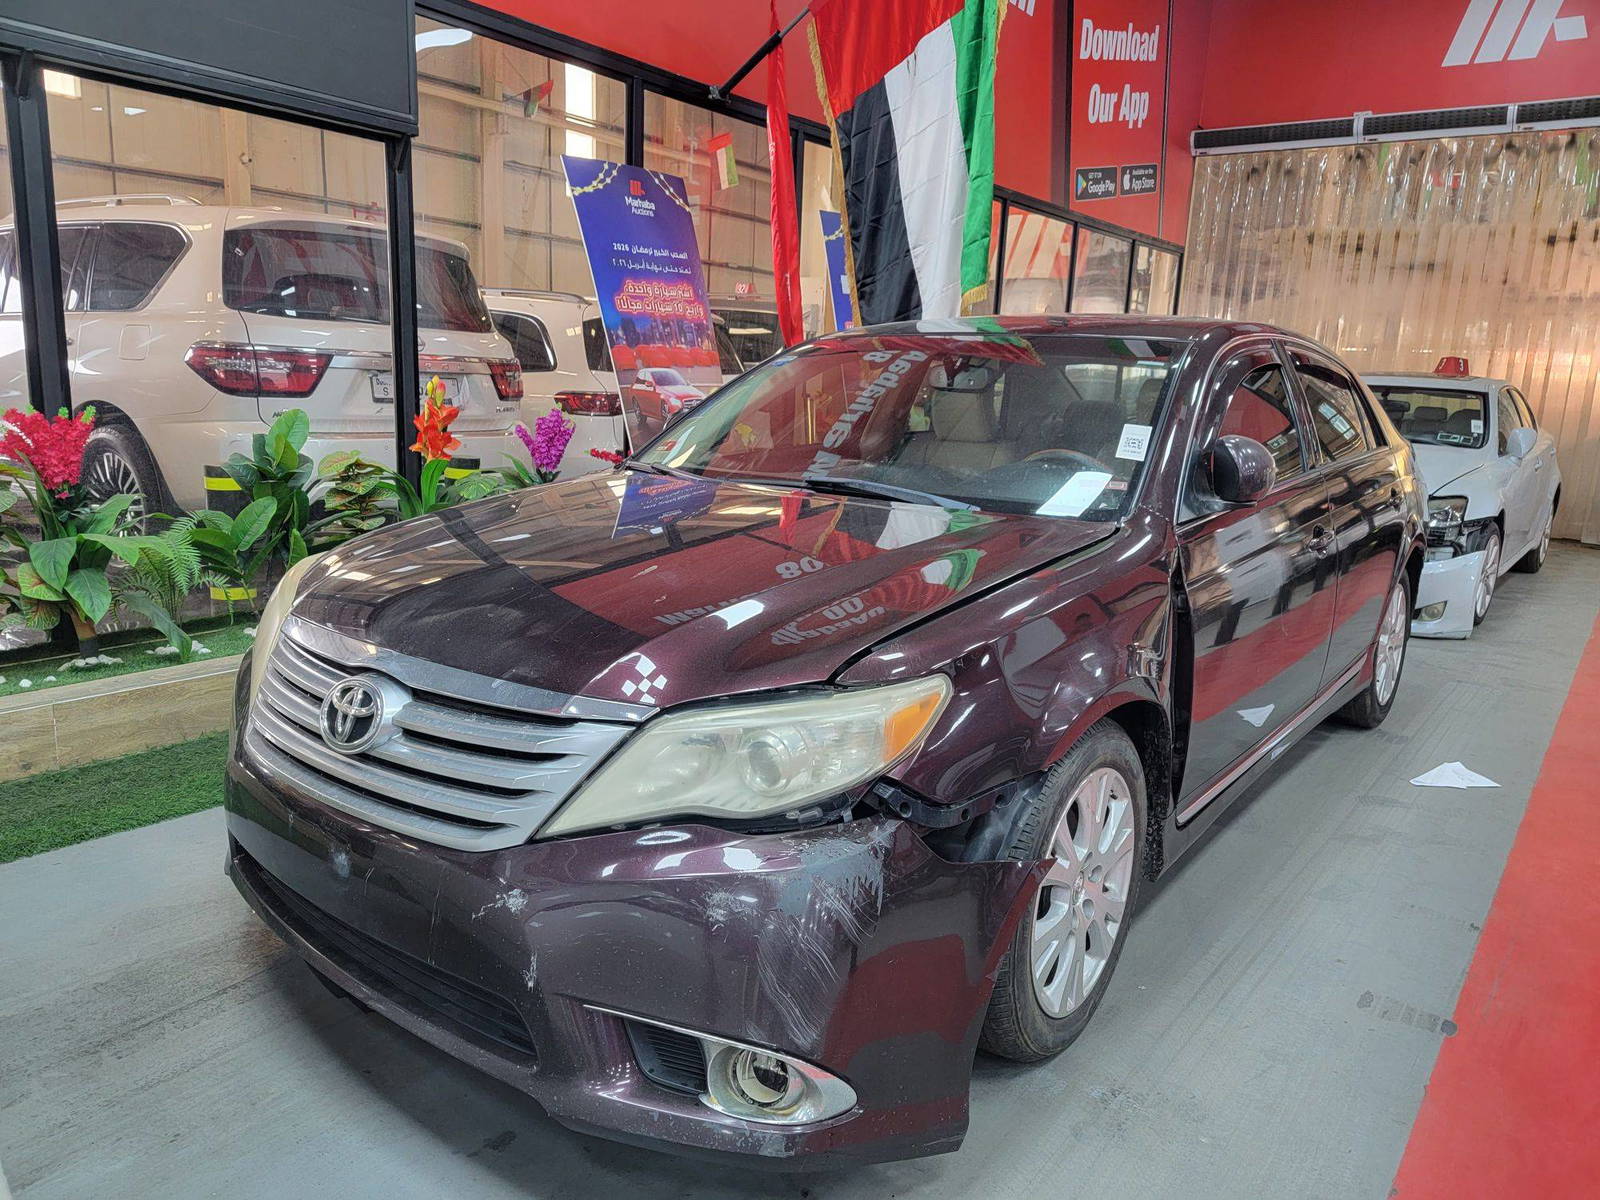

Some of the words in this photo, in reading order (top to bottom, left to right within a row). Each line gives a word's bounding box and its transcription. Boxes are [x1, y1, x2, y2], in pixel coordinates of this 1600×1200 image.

[1079, 18, 1160, 62] Download
[1087, 84, 1117, 124] Our
[1119, 83, 1149, 129] App
[1088, 181, 1105, 195] Google
[1105, 180, 1115, 194] Play
[1132, 178, 1142, 191] App
[1142, 177, 1155, 189] Store
[625, 195, 656, 210] Marhaba
[631, 207, 654, 217] Auctions
[613, 242, 630, 251] 2026
[654, 284, 677, 297] سيارة
[645, 299, 673, 313] سيارات
[382, 387, 389, 396] S
